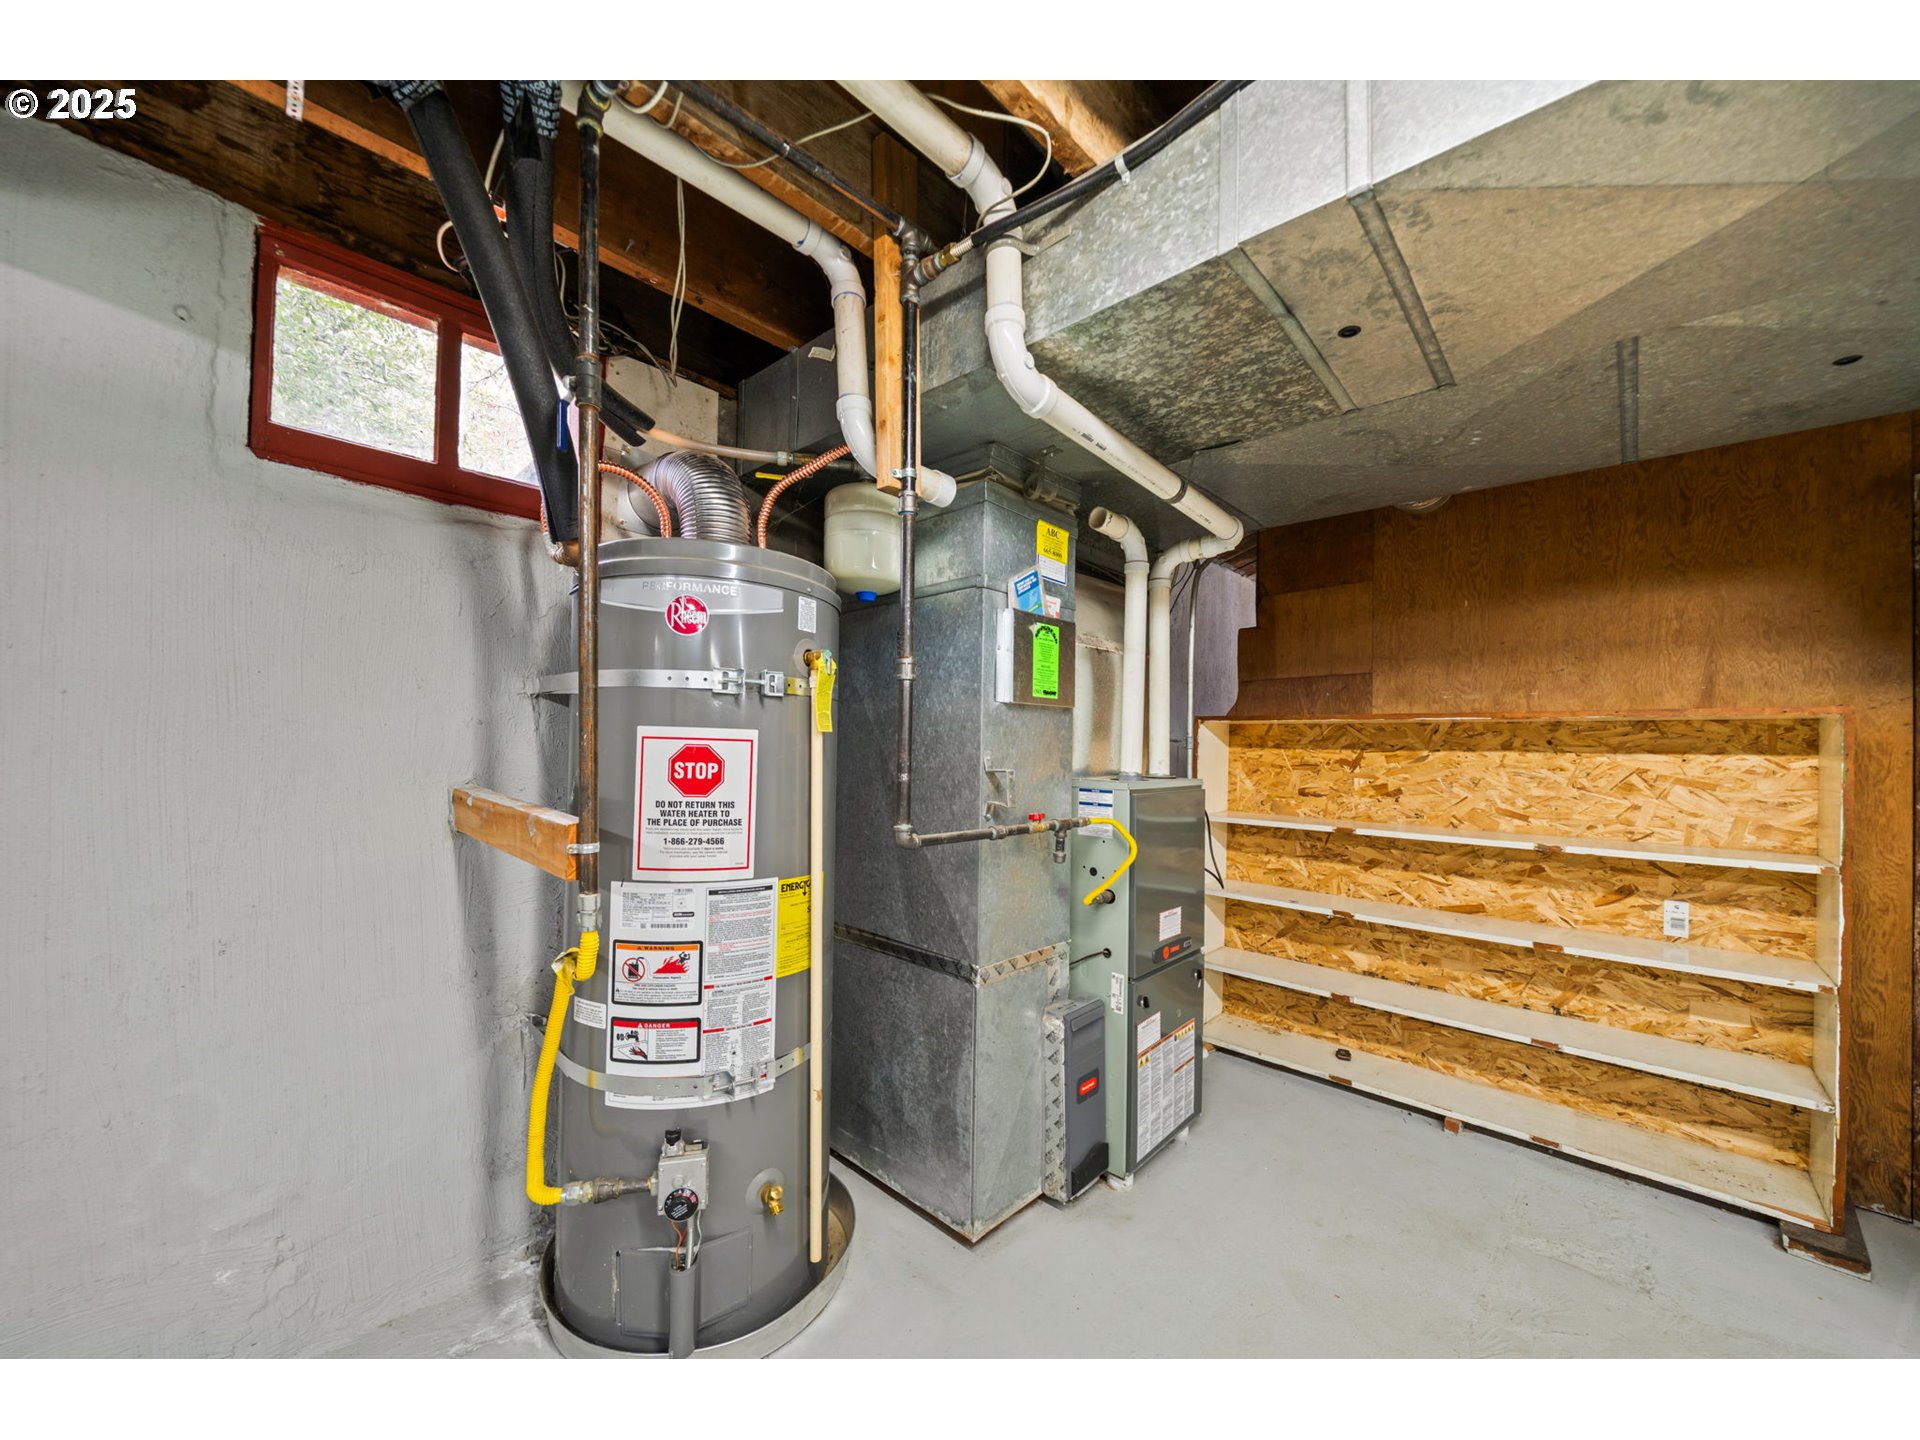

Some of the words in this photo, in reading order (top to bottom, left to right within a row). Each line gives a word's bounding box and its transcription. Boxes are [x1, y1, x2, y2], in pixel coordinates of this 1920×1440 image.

[642, 581, 737, 596] PERFORMANCE
[669, 594, 707, 630] Rheem
[673, 761, 719, 780] STOP
[655, 800, 666, 809] DO
[668, 801, 683, 809] NOT
[685, 801, 716, 809] RETURN
[718, 801, 736, 809] THIS
[660, 809, 686, 818] WATER
[688, 810, 718, 818] HEATER
[720, 810, 730, 818] TO
[647, 818, 661, 827] THE
[663, 819, 687, 827] PLACE
[690, 819, 700, 827] OF
[702, 818, 743, 827] PURCHASE
[663, 837, 725, 846] 1-866-279-4566
